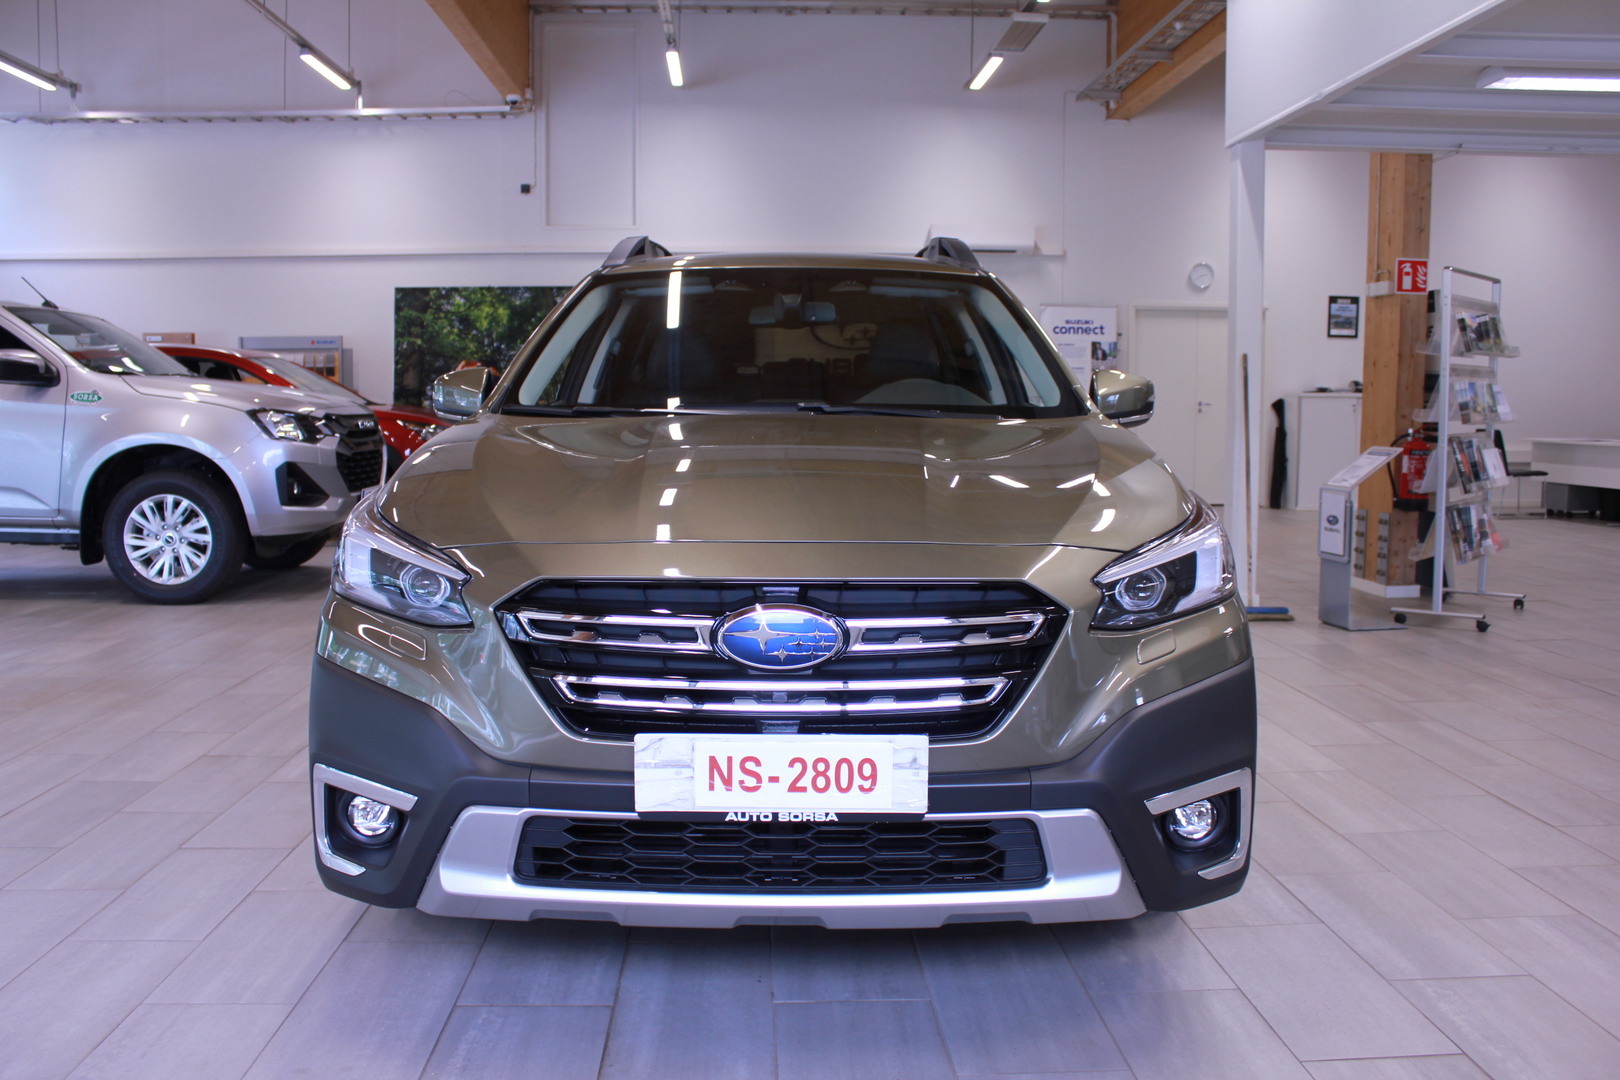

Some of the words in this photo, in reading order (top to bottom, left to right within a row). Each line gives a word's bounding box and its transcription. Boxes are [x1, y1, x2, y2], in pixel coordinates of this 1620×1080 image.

[1053, 325, 1105, 335] connect
[73, 393, 98, 401] SORSA
[708, 756, 878, 794] NS-2809
[724, 812, 772, 822] AUTO
[778, 812, 838, 822] SORSA
